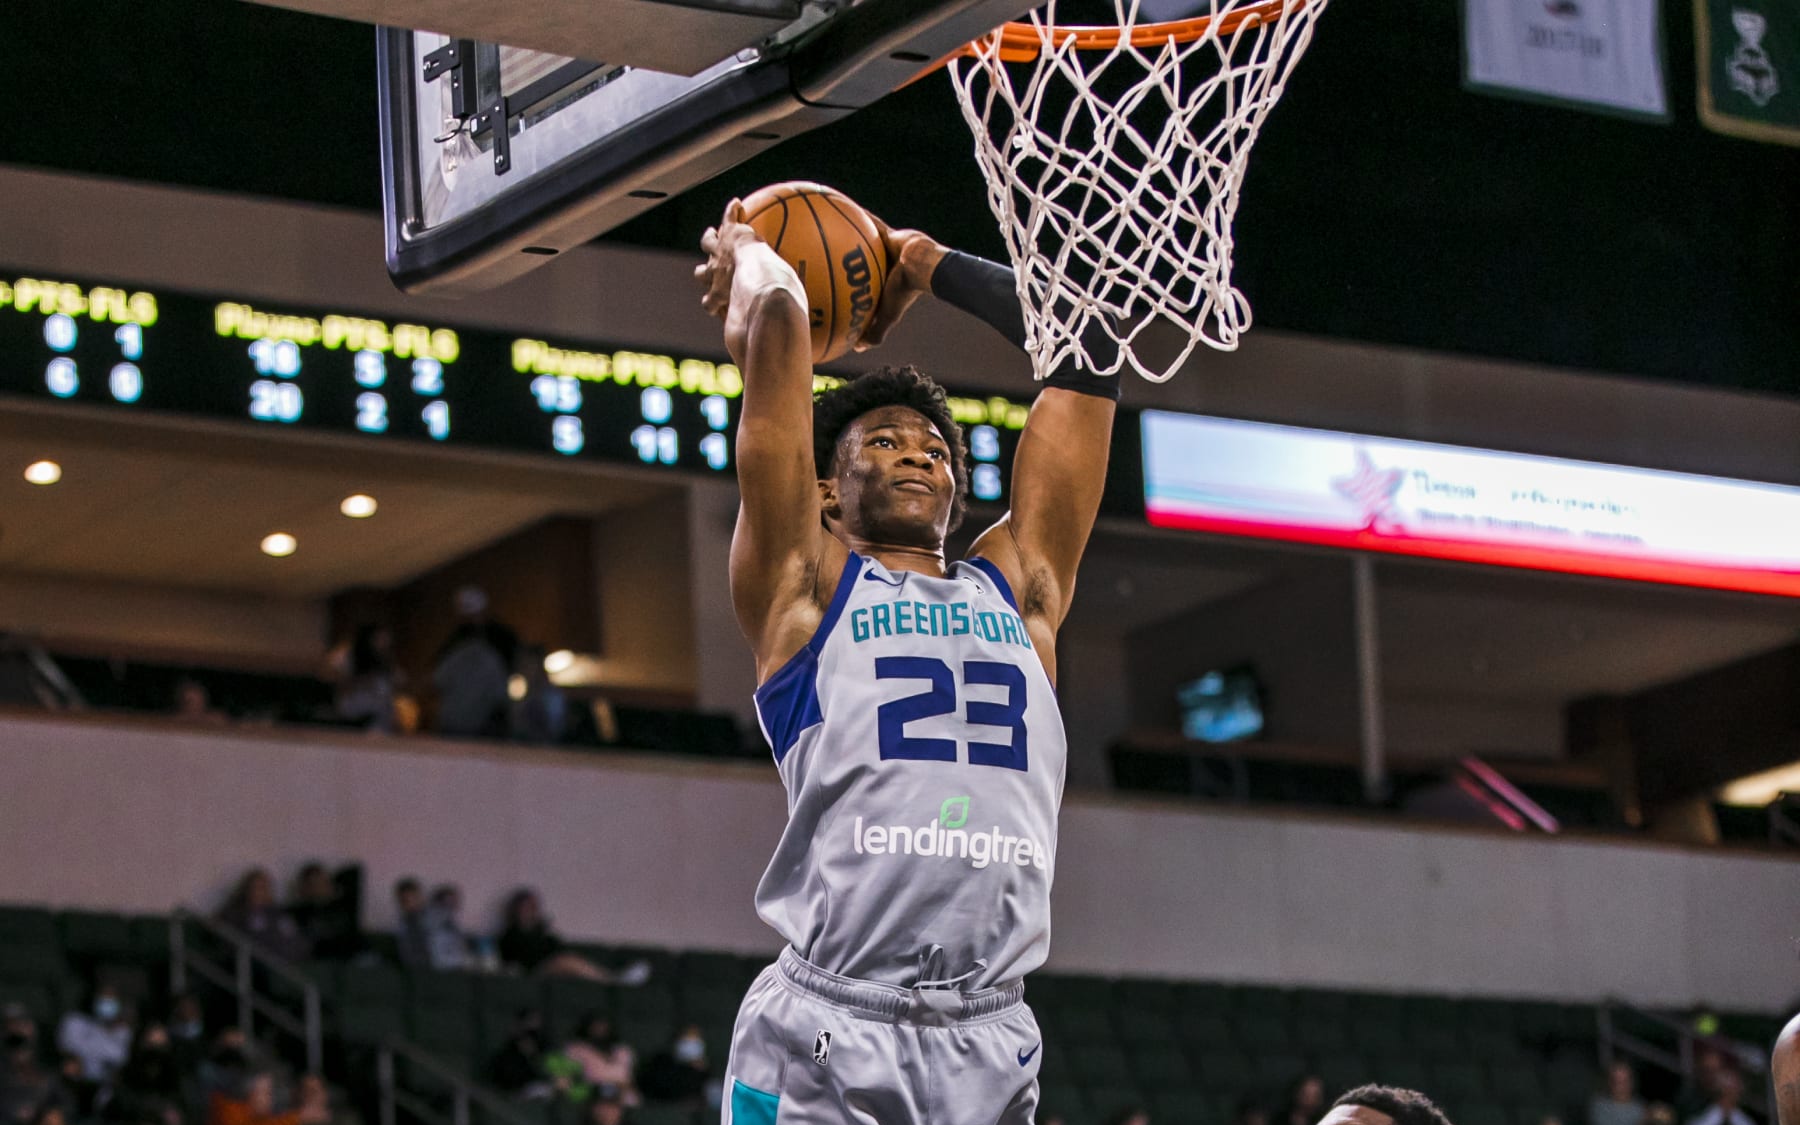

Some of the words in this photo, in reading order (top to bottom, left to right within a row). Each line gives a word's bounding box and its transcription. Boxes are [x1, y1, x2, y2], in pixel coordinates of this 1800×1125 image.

[114, 322, 143, 361] 1
[356, 391, 389, 433] 2
[422, 400, 450, 440] 1
[700, 393, 728, 431] 1
[630, 424, 679, 465] 11
[700, 432, 728, 470] 1
[875, 656, 1028, 772] 23
[854, 815, 1046, 869] lendingtree
